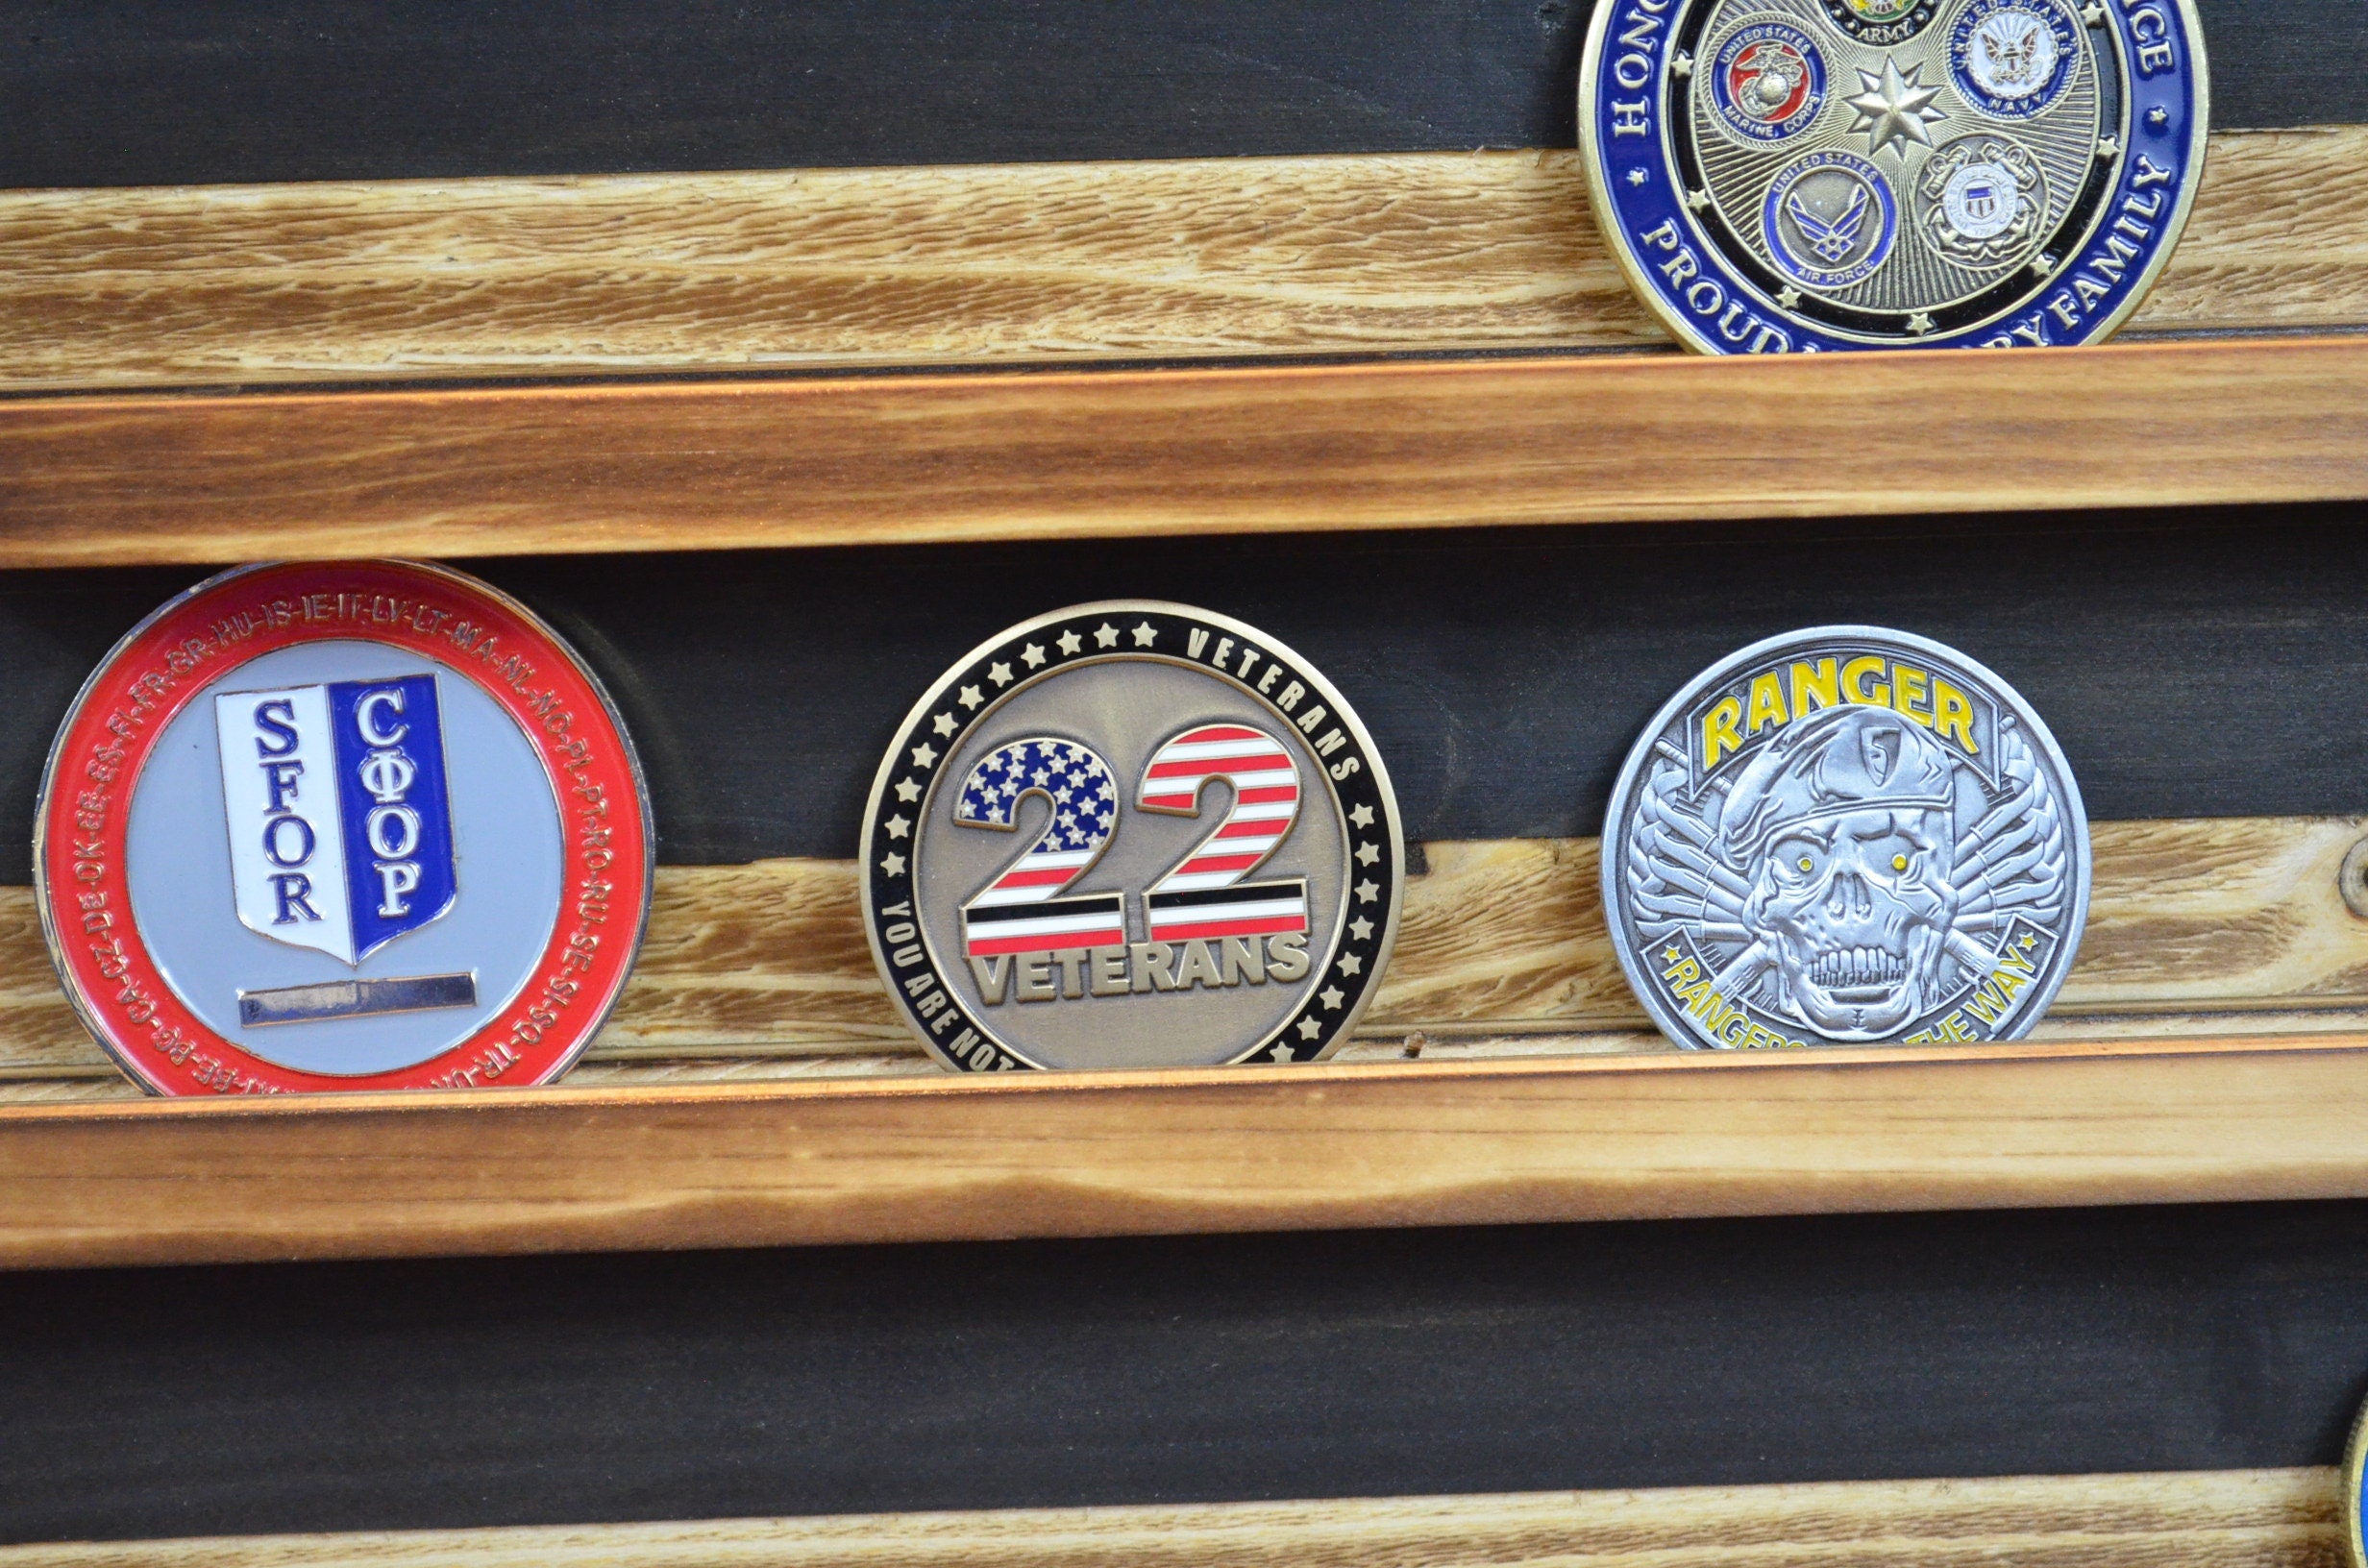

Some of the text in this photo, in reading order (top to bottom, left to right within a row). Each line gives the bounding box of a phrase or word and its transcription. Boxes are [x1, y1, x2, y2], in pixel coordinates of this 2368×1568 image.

[1719, 25, 1812, 64] UNITED STATES
[1857, 19, 1911, 43] ARMY
[1723, 93, 1821, 137] MARINE CORPS
[1989, 93, 2042, 112] NAVY
[1772, 152, 1879, 193] UNITED STATES
[1640, 218, 1789, 354] PROUD
[1796, 259, 1874, 283] AIR FORCE
[2047, 154, 2170, 331] FAMILY
[1187, 625, 1361, 782] VETERANS
[1699, 655, 1980, 772] RANGER
[253, 698, 323, 925] SFOR
[952, 723, 1310, 959] 22
[881, 900, 1016, 1072] YOU ARE NOT
[963, 932, 1312, 1006] VETERANS
[1660, 955, 1809, 1049] RANGER
[1961, 942, 2036, 1028] WAY
